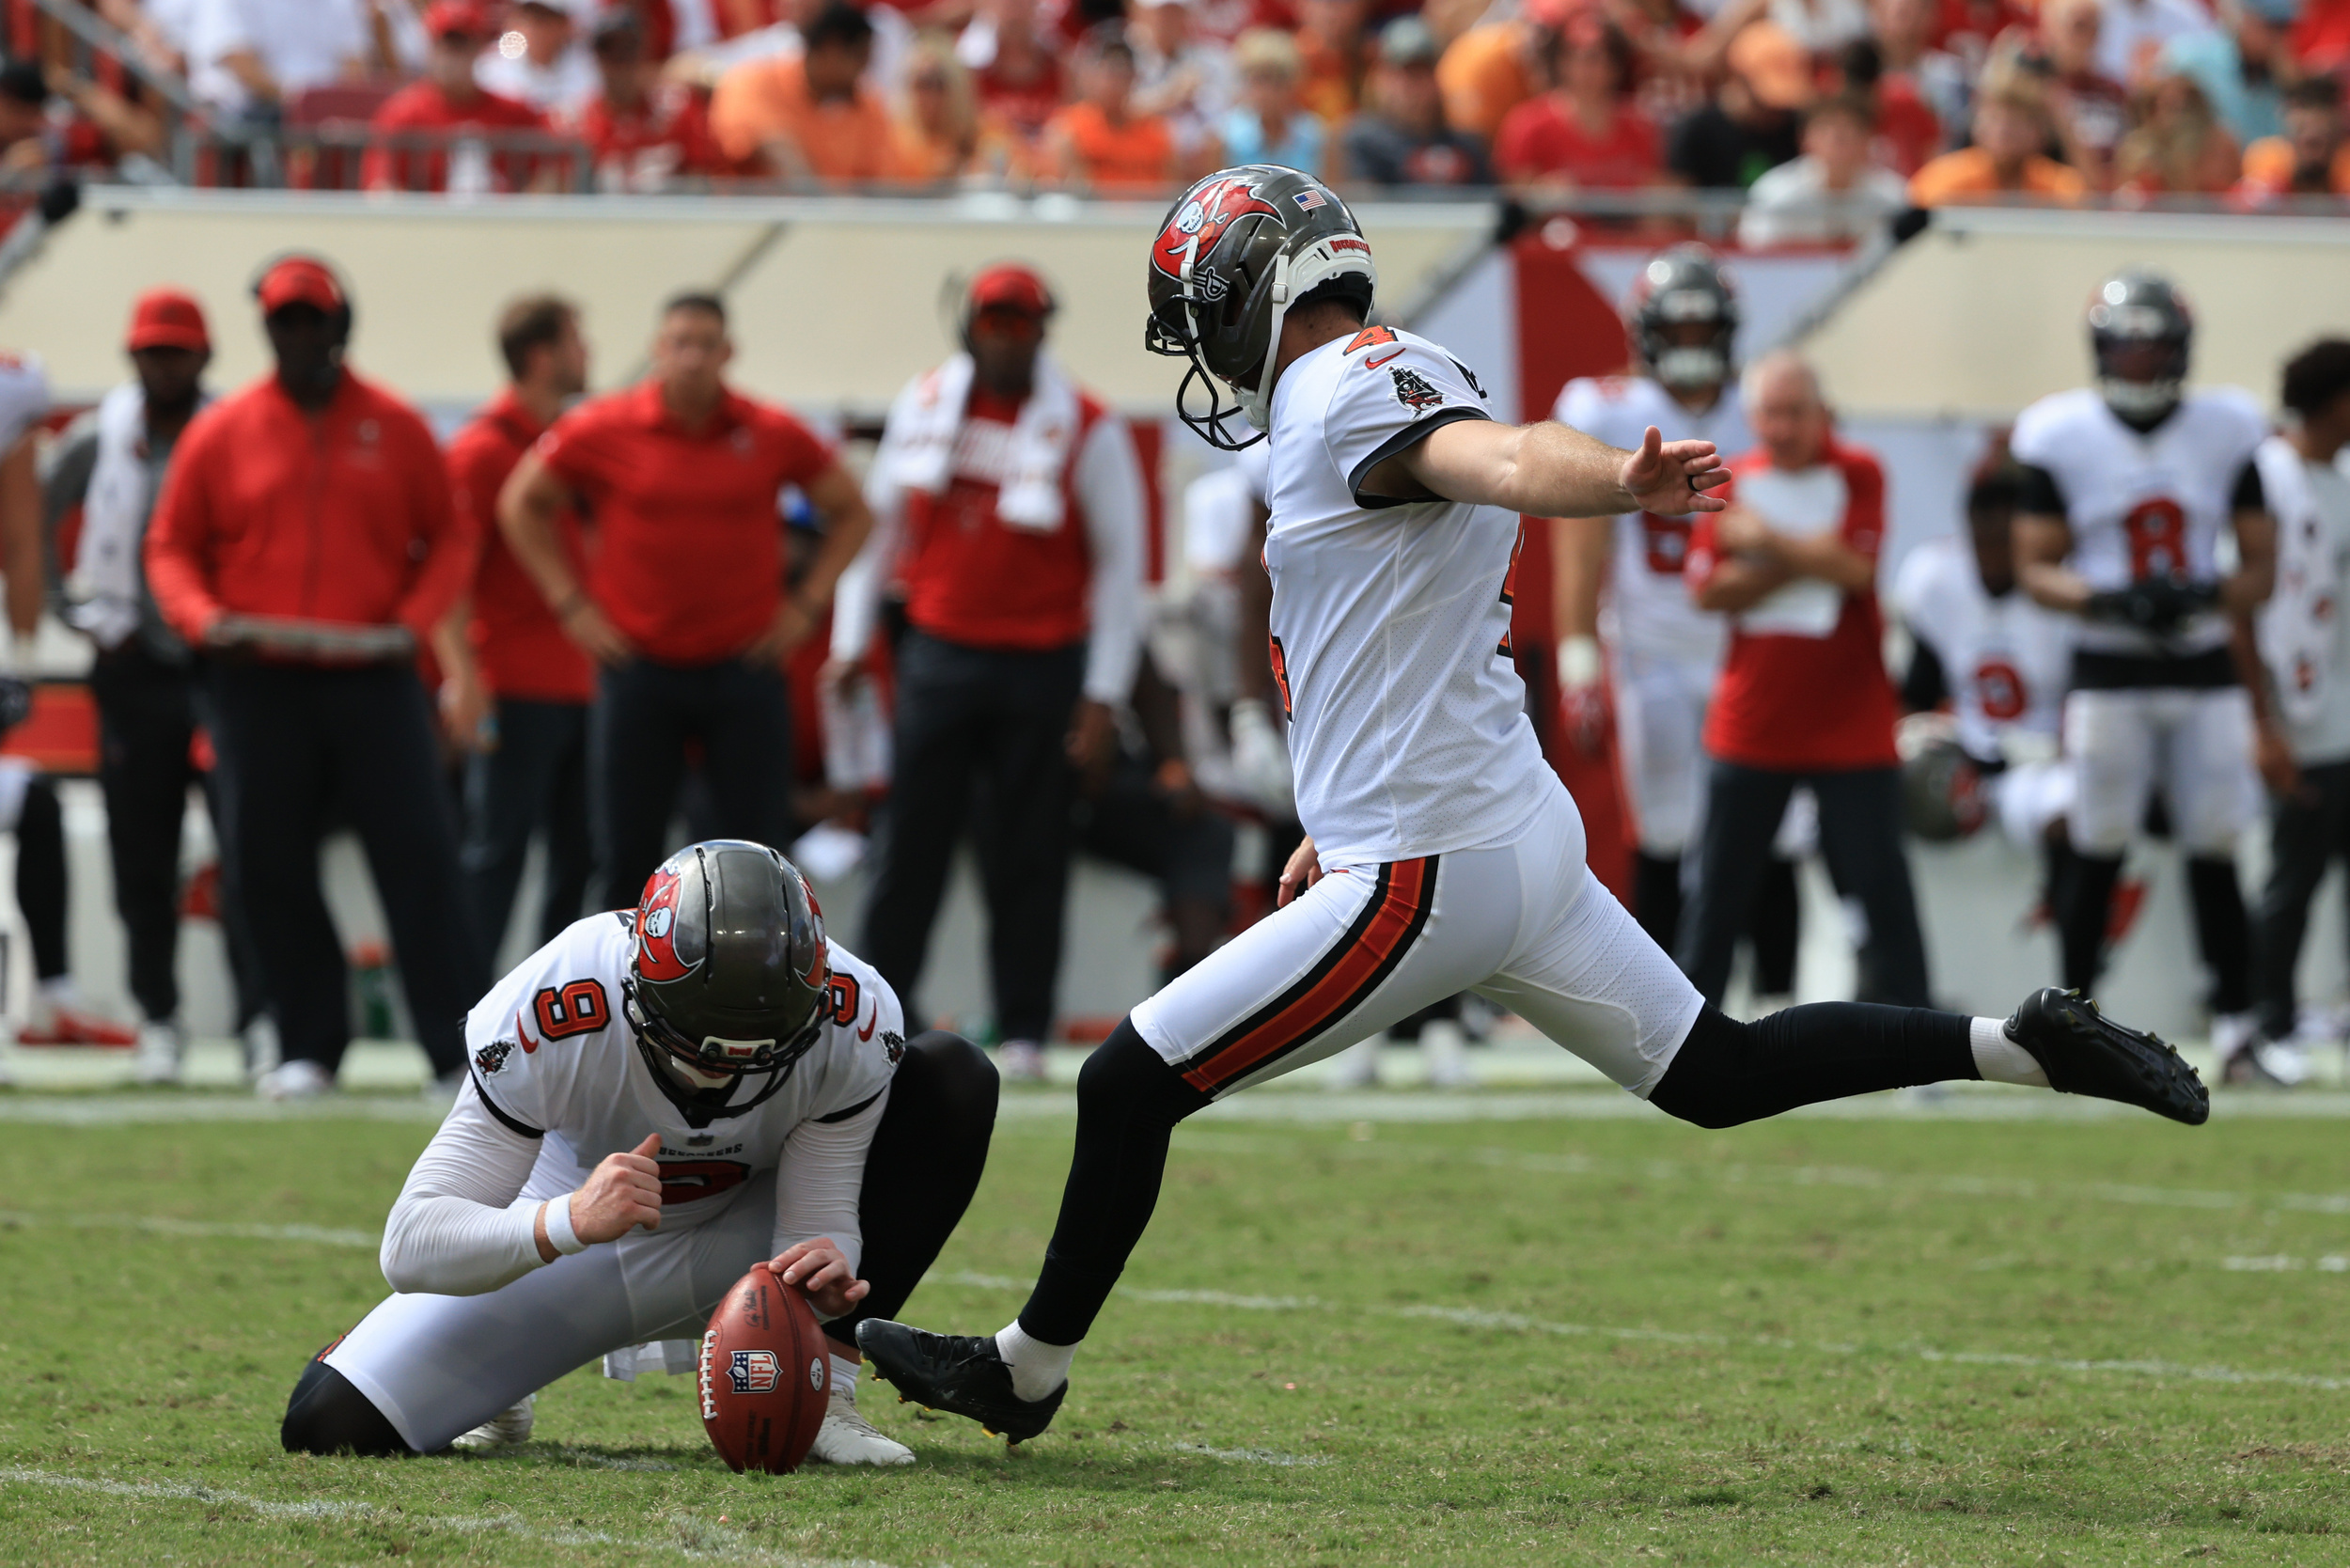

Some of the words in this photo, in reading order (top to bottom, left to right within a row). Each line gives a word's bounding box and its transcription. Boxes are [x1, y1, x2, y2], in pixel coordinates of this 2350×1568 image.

[1342, 325, 1399, 356] 4
[533, 978, 611, 1043] 9
[750, 1355, 774, 1388] NFL
